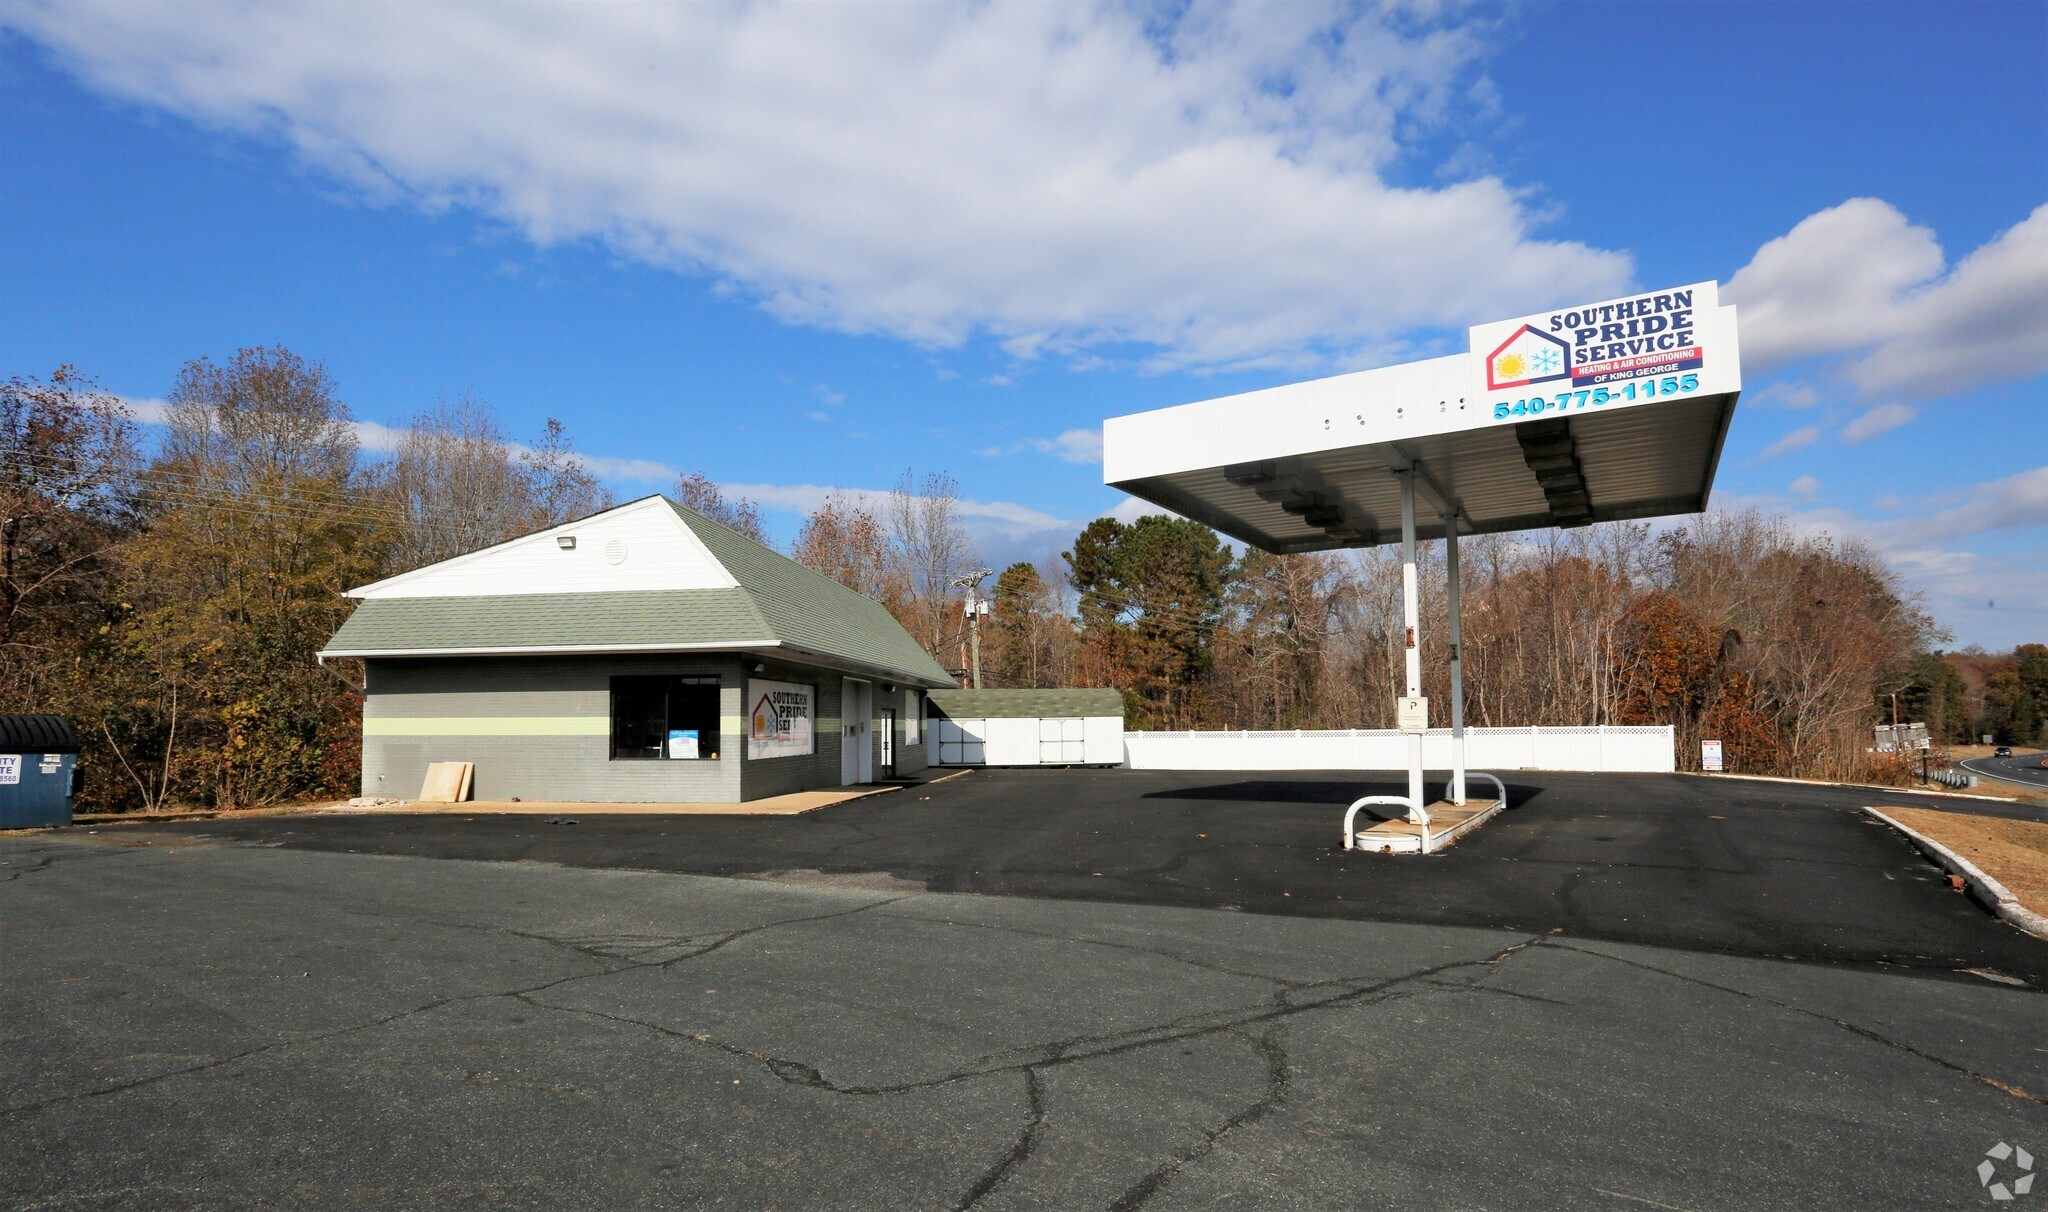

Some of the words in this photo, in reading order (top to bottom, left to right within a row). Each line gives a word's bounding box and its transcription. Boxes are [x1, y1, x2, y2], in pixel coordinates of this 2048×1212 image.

[1550, 290, 1692, 332] SOUTHERN
[1575, 309, 1693, 347] PRIDE
[1575, 330, 1693, 364] SERVICE
[1578, 362, 1611, 375] HEATING
[1613, 360, 1619, 370] &
[1620, 358, 1634, 369] AIR
[1636, 349, 1695, 366] CONDITIONING
[1594, 373, 1607, 383] OF
[1609, 369, 1633, 381] KING
[1635, 362, 1679, 377] GEORGE
[1493, 373, 1700, 420] 540-775-1155
[773, 691, 807, 705] SOUTHERN
[779, 705, 808, 719] PRIDE
